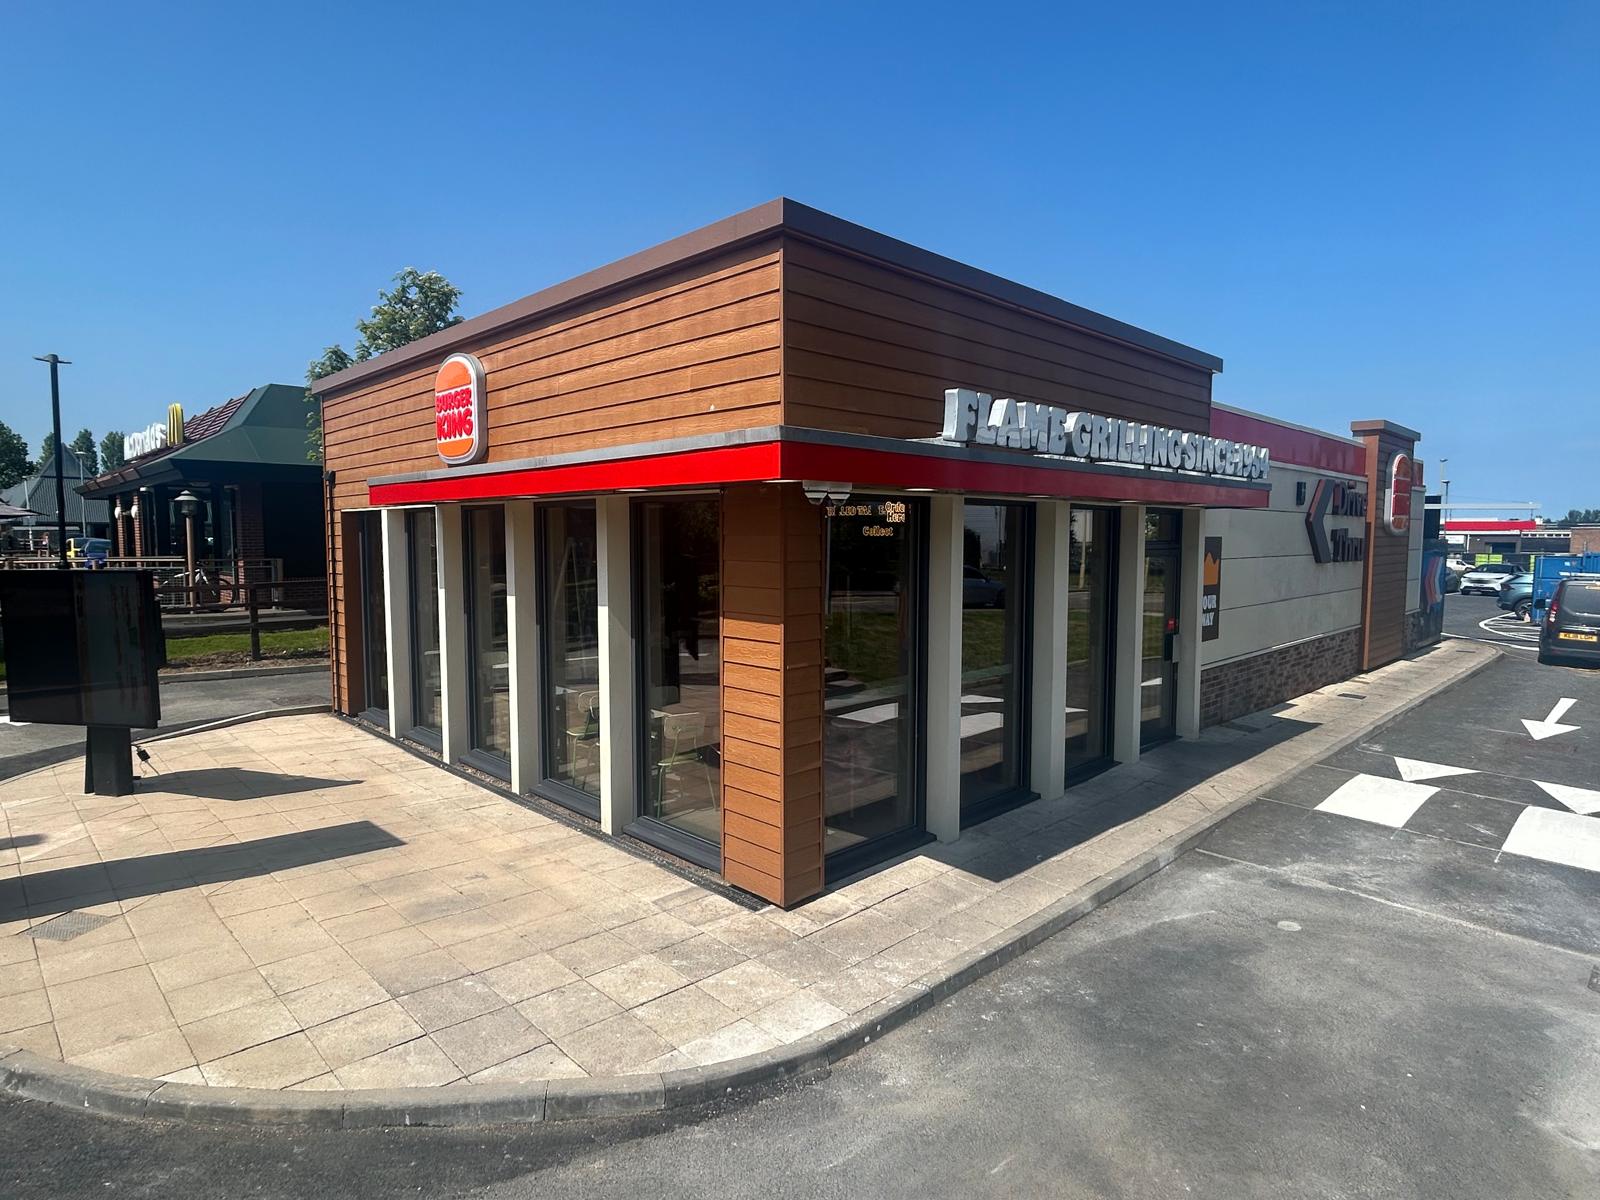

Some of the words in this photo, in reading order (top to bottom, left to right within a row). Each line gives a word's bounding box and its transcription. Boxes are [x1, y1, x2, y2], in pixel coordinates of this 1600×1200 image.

[435, 387, 473, 414] BURGER
[436, 408, 474, 441] KING
[943, 388, 1067, 455] FLAME
[1066, 411, 1182, 469] GRILLING
[1182, 432, 1236, 474] SINCE
[1202, 594, 1217, 610] OUR
